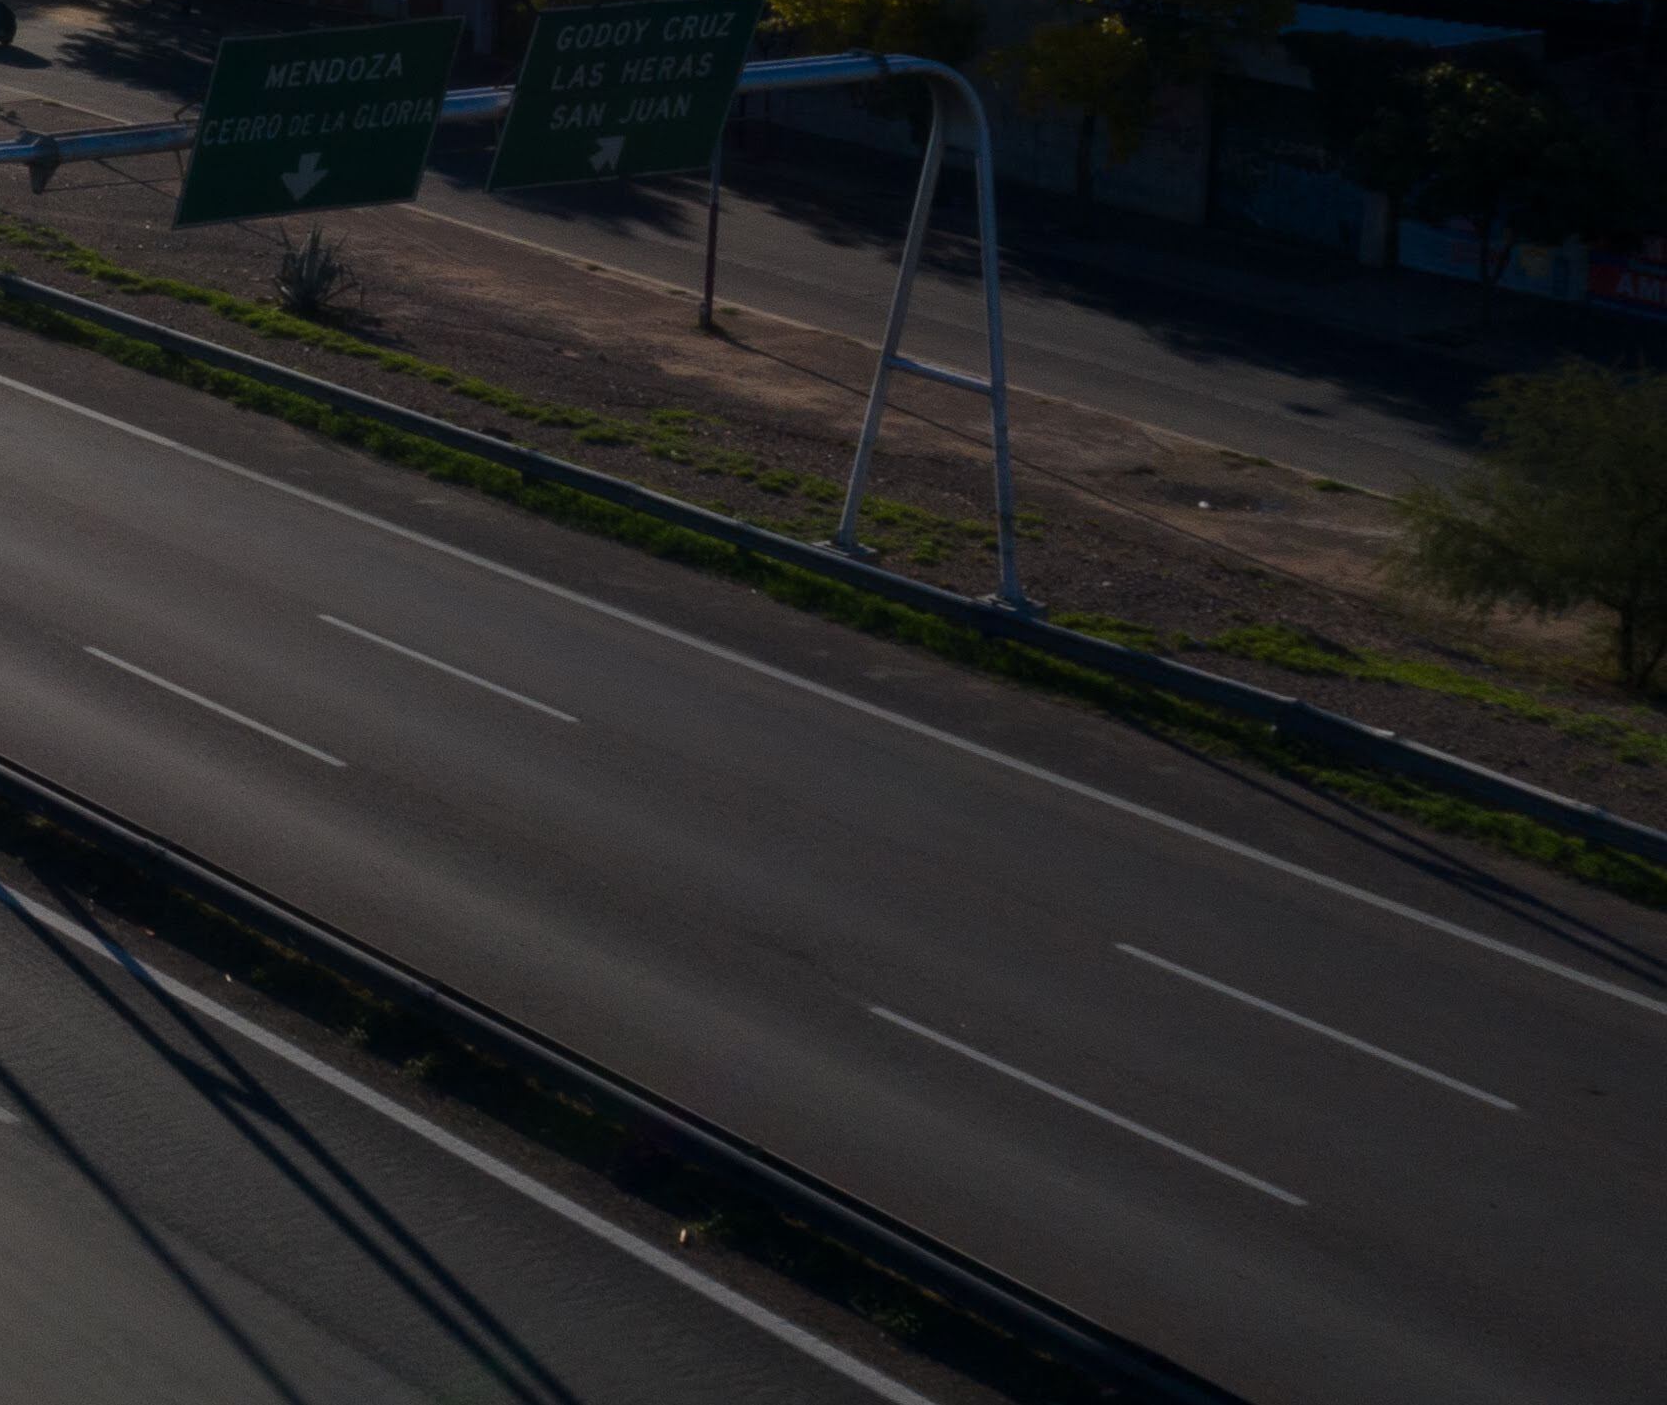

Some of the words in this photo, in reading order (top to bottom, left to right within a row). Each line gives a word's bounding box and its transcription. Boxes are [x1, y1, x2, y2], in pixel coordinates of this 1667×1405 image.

[556, 17, 652, 51] GODOY
[663, 11, 737, 41] CRUZ
[264, 52, 404, 90] MENDOZA
[550, 61, 606, 91] LAS
[620, 52, 715, 84] HERAS
[202, 113, 283, 147] CERRO
[287, 113, 315, 137] DE
[320, 111, 345, 135] LA
[352, 97, 435, 131] GLORIA
[549, 101, 607, 131] SAN
[618, 93, 693, 125] JUAN
